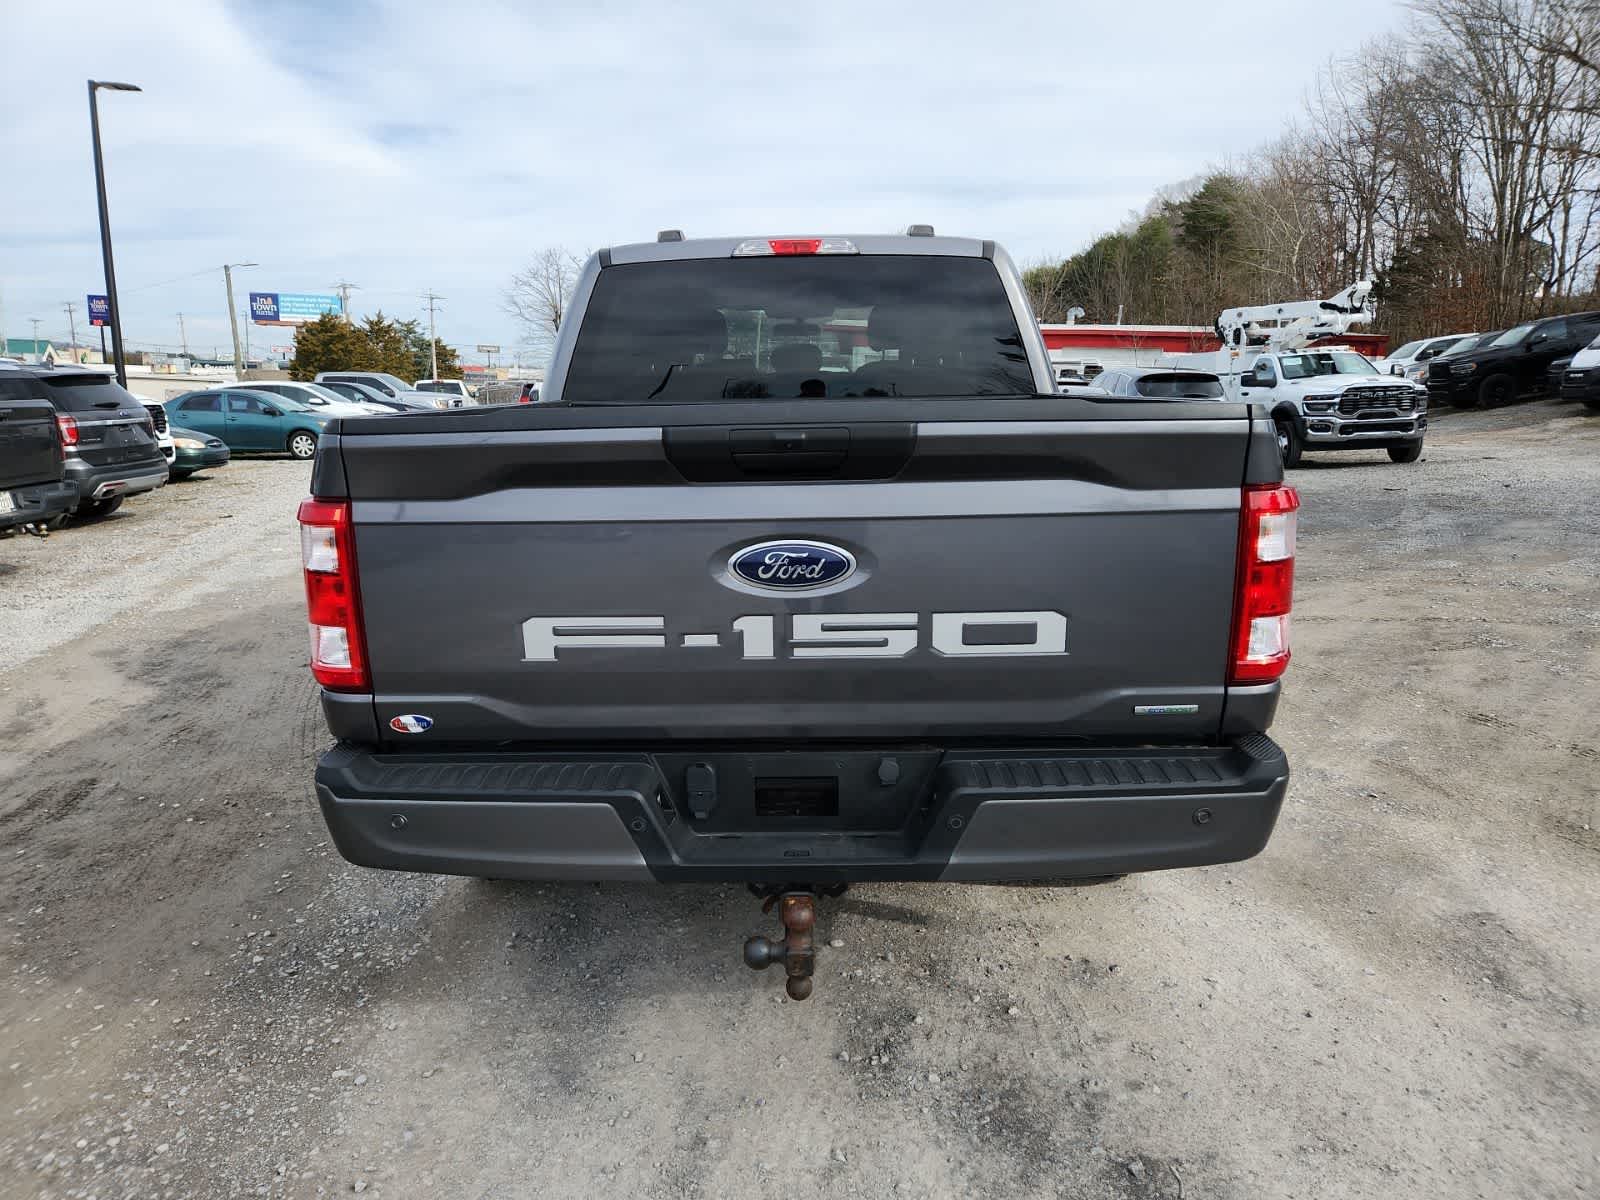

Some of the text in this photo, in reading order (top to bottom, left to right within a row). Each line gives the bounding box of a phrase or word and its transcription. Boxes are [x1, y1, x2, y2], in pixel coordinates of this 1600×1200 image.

[251, 303, 277, 312] Town
[758, 551, 825, 579] Ford
[521, 611, 1070, 662] F-150
